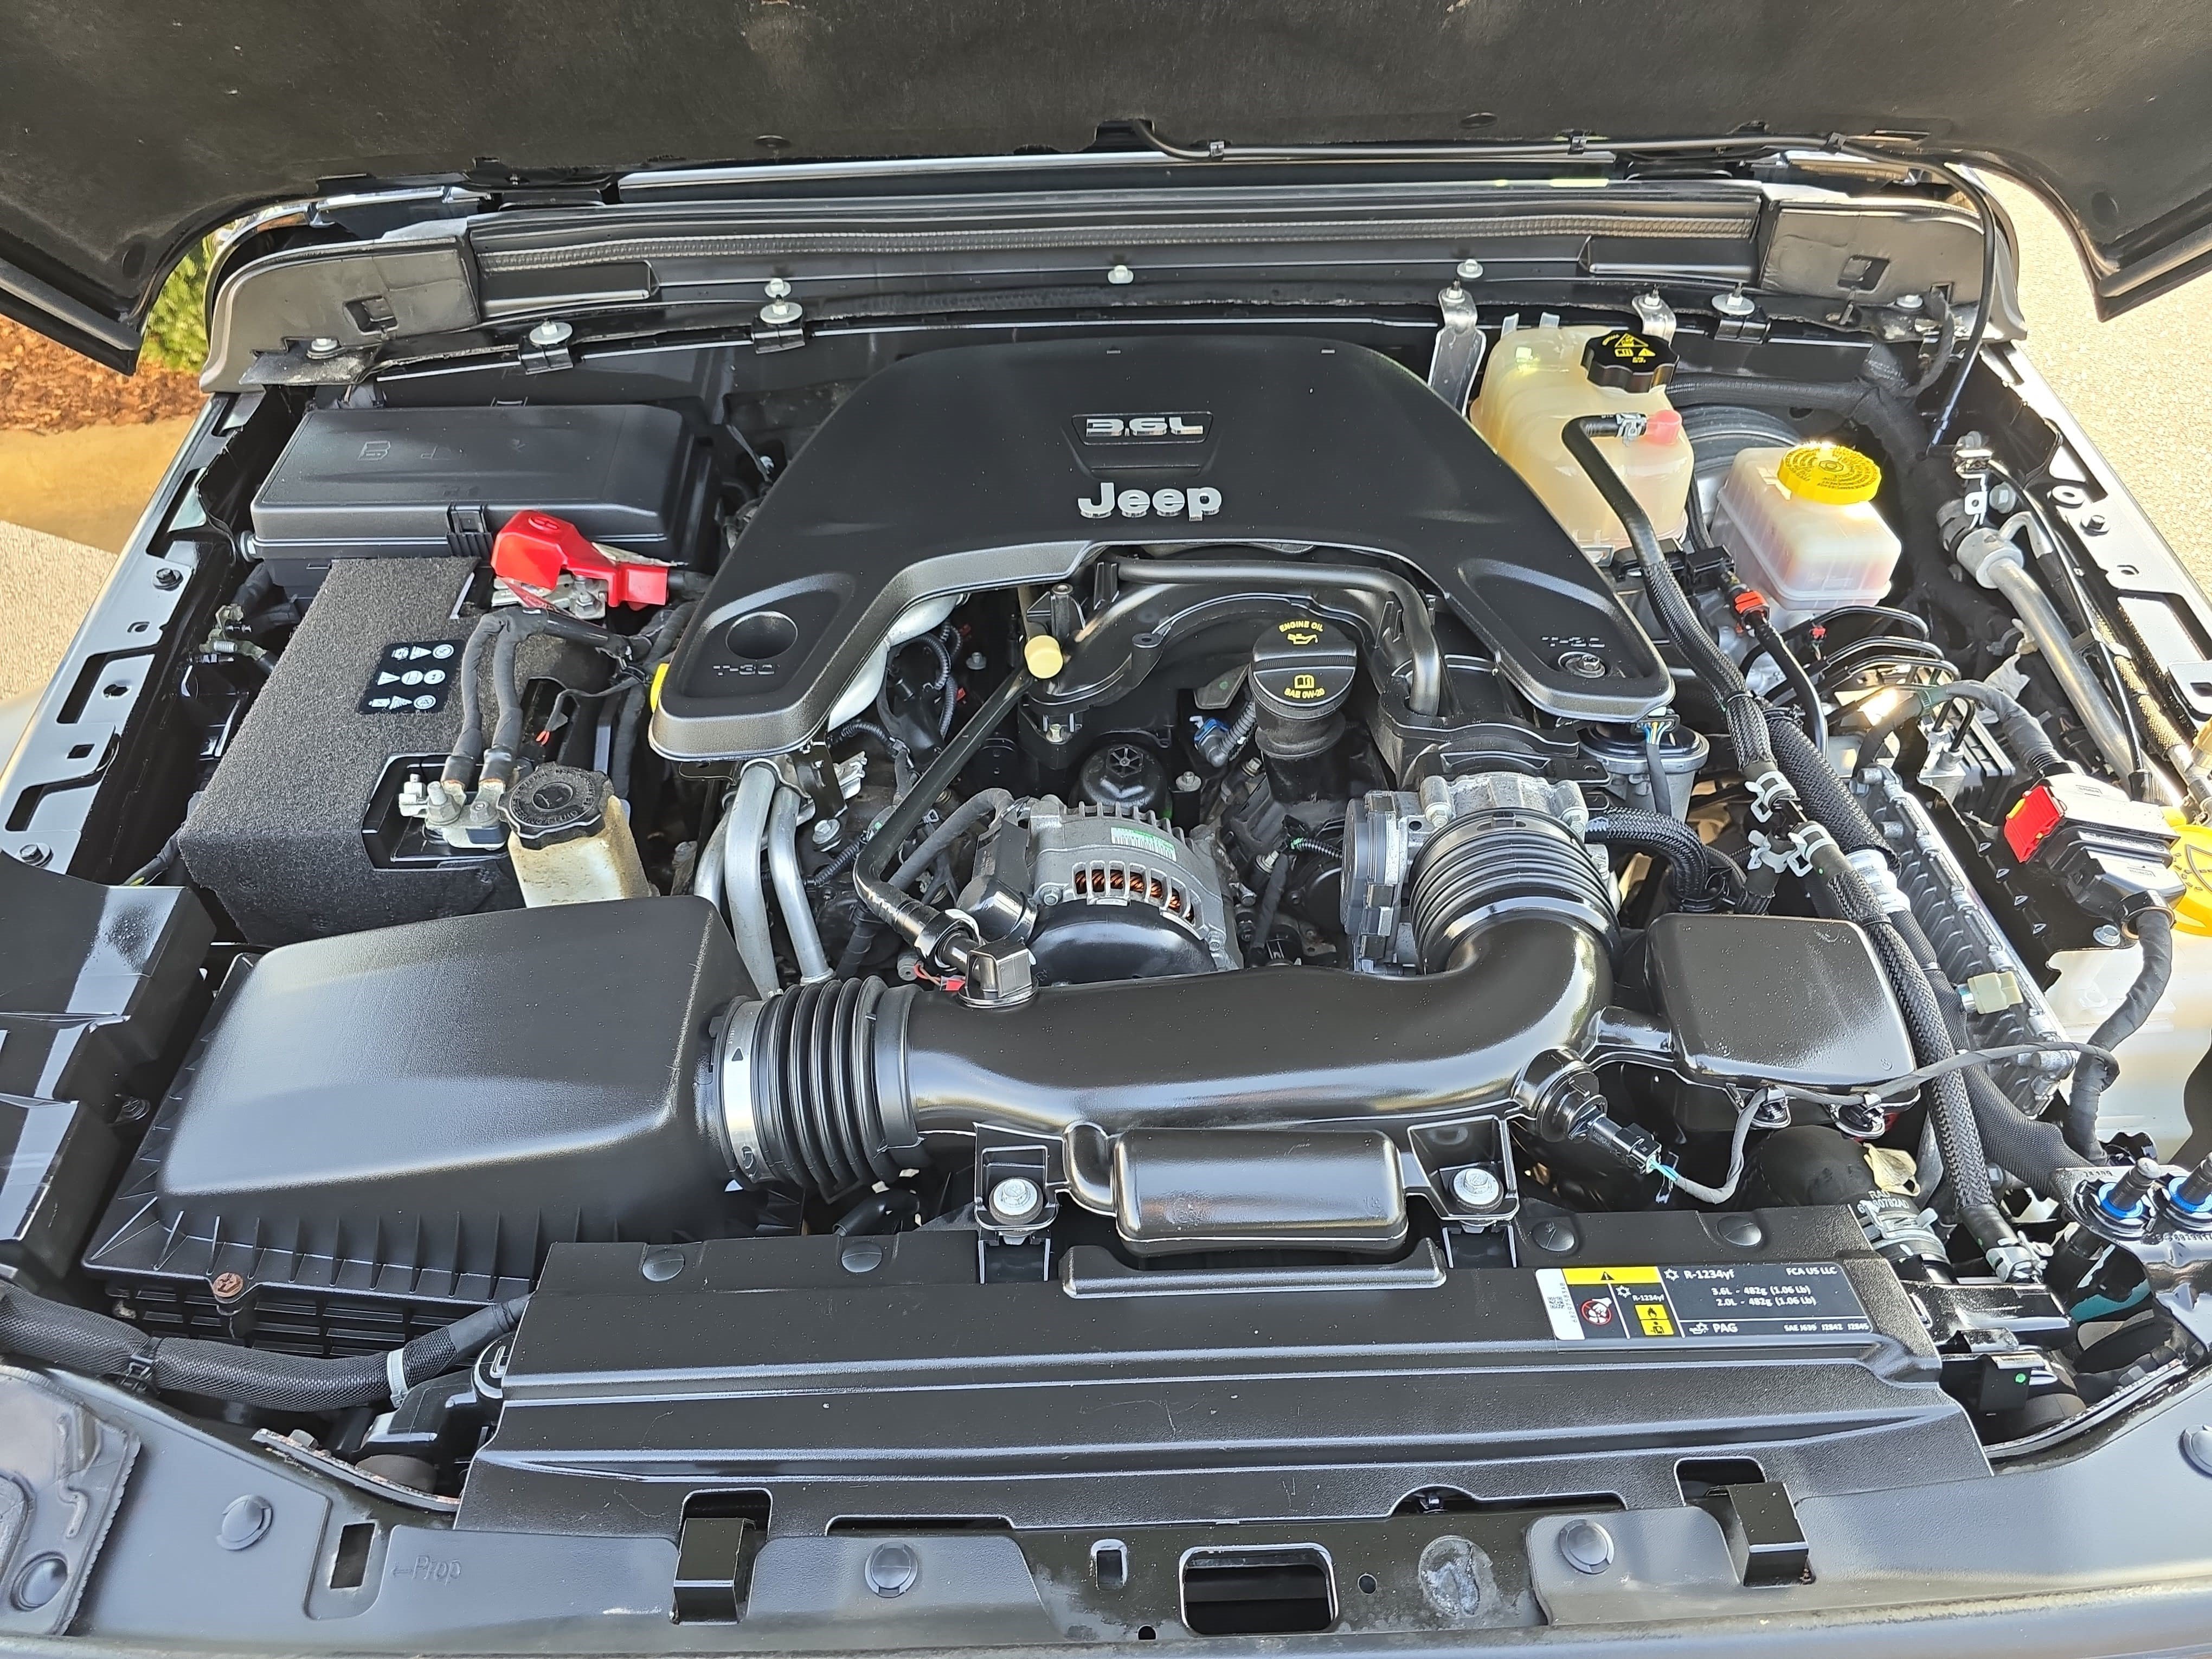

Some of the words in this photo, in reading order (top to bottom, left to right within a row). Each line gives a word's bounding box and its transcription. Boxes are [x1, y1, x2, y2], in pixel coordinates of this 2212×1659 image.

[1085, 416, 1204, 437] 3.6L
[1077, 482, 1222, 522] Jeep
[1278, 620, 1310, 633] ENGINE
[1311, 622, 1323, 632] OIL
[1284, 687, 1301, 698] SAE
[1302, 687, 1325, 699] 0W-20
[1683, 1269, 1735, 1280] R-1234yf
[1786, 1268, 1805, 1276] FCA
[1805, 1267, 1820, 1275] US
[1821, 1266, 1837, 1275] LLC
[1711, 1287, 1733, 1296] 3.6L
[1744, 1287, 1768, 1296] 482g
[1770, 1285, 1795, 1295] (1.06
[1795, 1285, 1811, 1295] Lb)
[1632, 1294, 1665, 1303] R-1234yf
[1715, 1298, 1737, 1307] 2.0L
[1748, 1297, 1773, 1307] 482g
[1774, 1296, 1800, 1307] (1.06
[1800, 1296, 1816, 1306] Lb)
[1712, 1323, 1739, 1333] PAG
[411, 1555, 461, 1587] Prop
